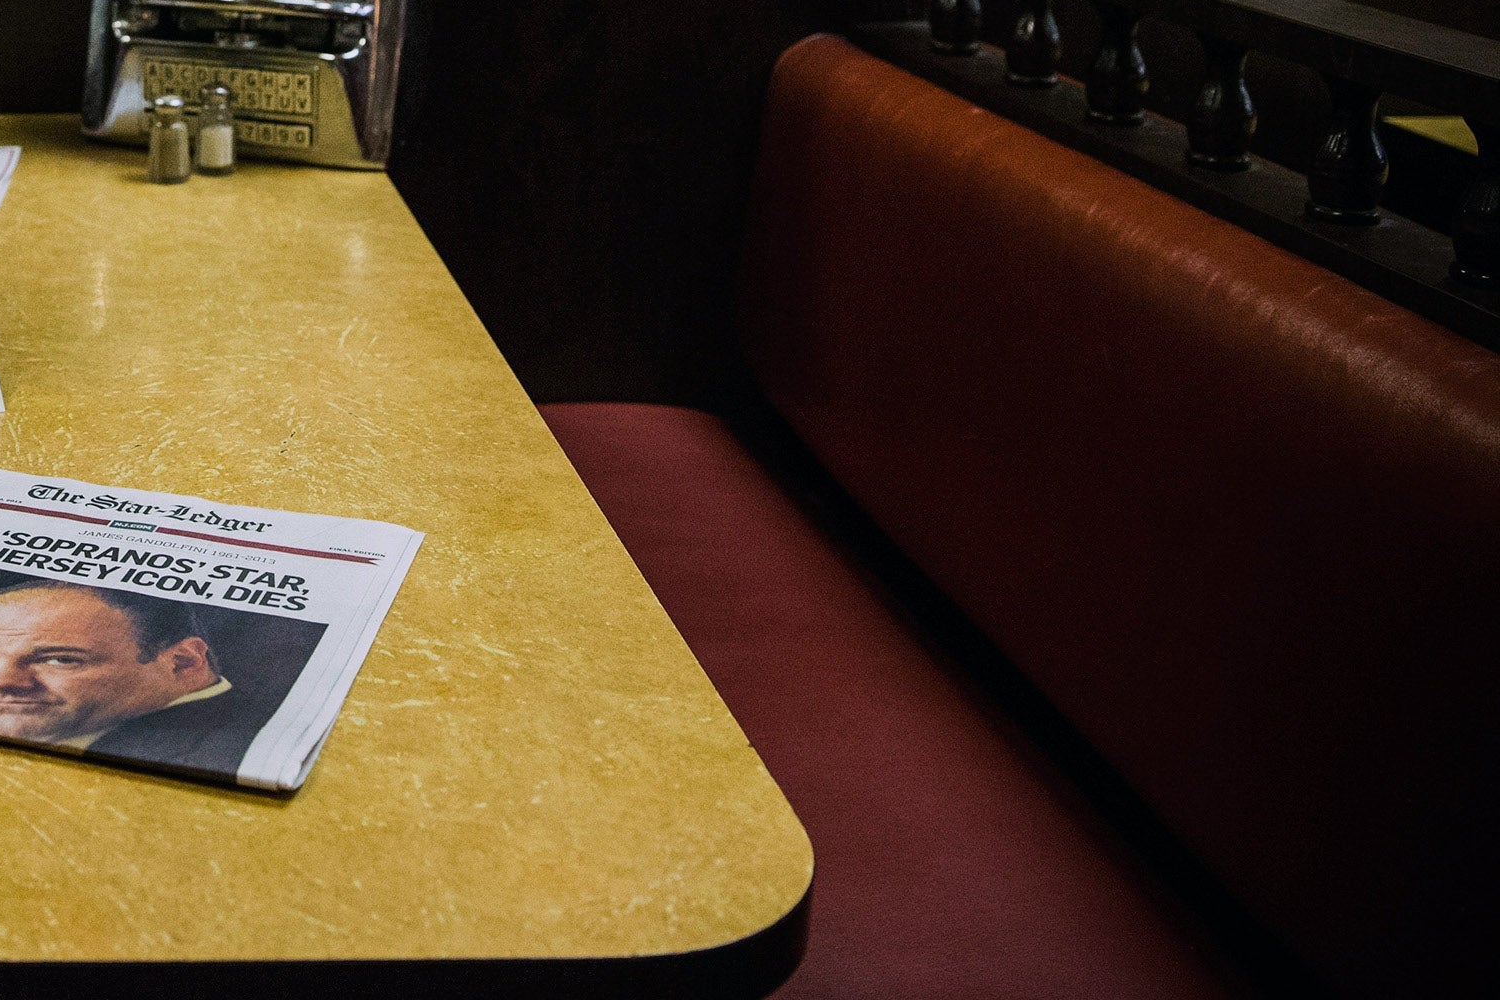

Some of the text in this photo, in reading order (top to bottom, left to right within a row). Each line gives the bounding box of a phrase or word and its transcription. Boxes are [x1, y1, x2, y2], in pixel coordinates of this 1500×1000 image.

[27, 484, 273, 534] The Star-Ledger
[113, 521, 154, 531] NJ.COM
[78, 531, 277, 564] JAMES GANDOLFINI 1961-2013
[120, 568, 213, 599] ICON,
[222, 585, 309, 611] DIES
[207, 564, 310, 596] STAR,
